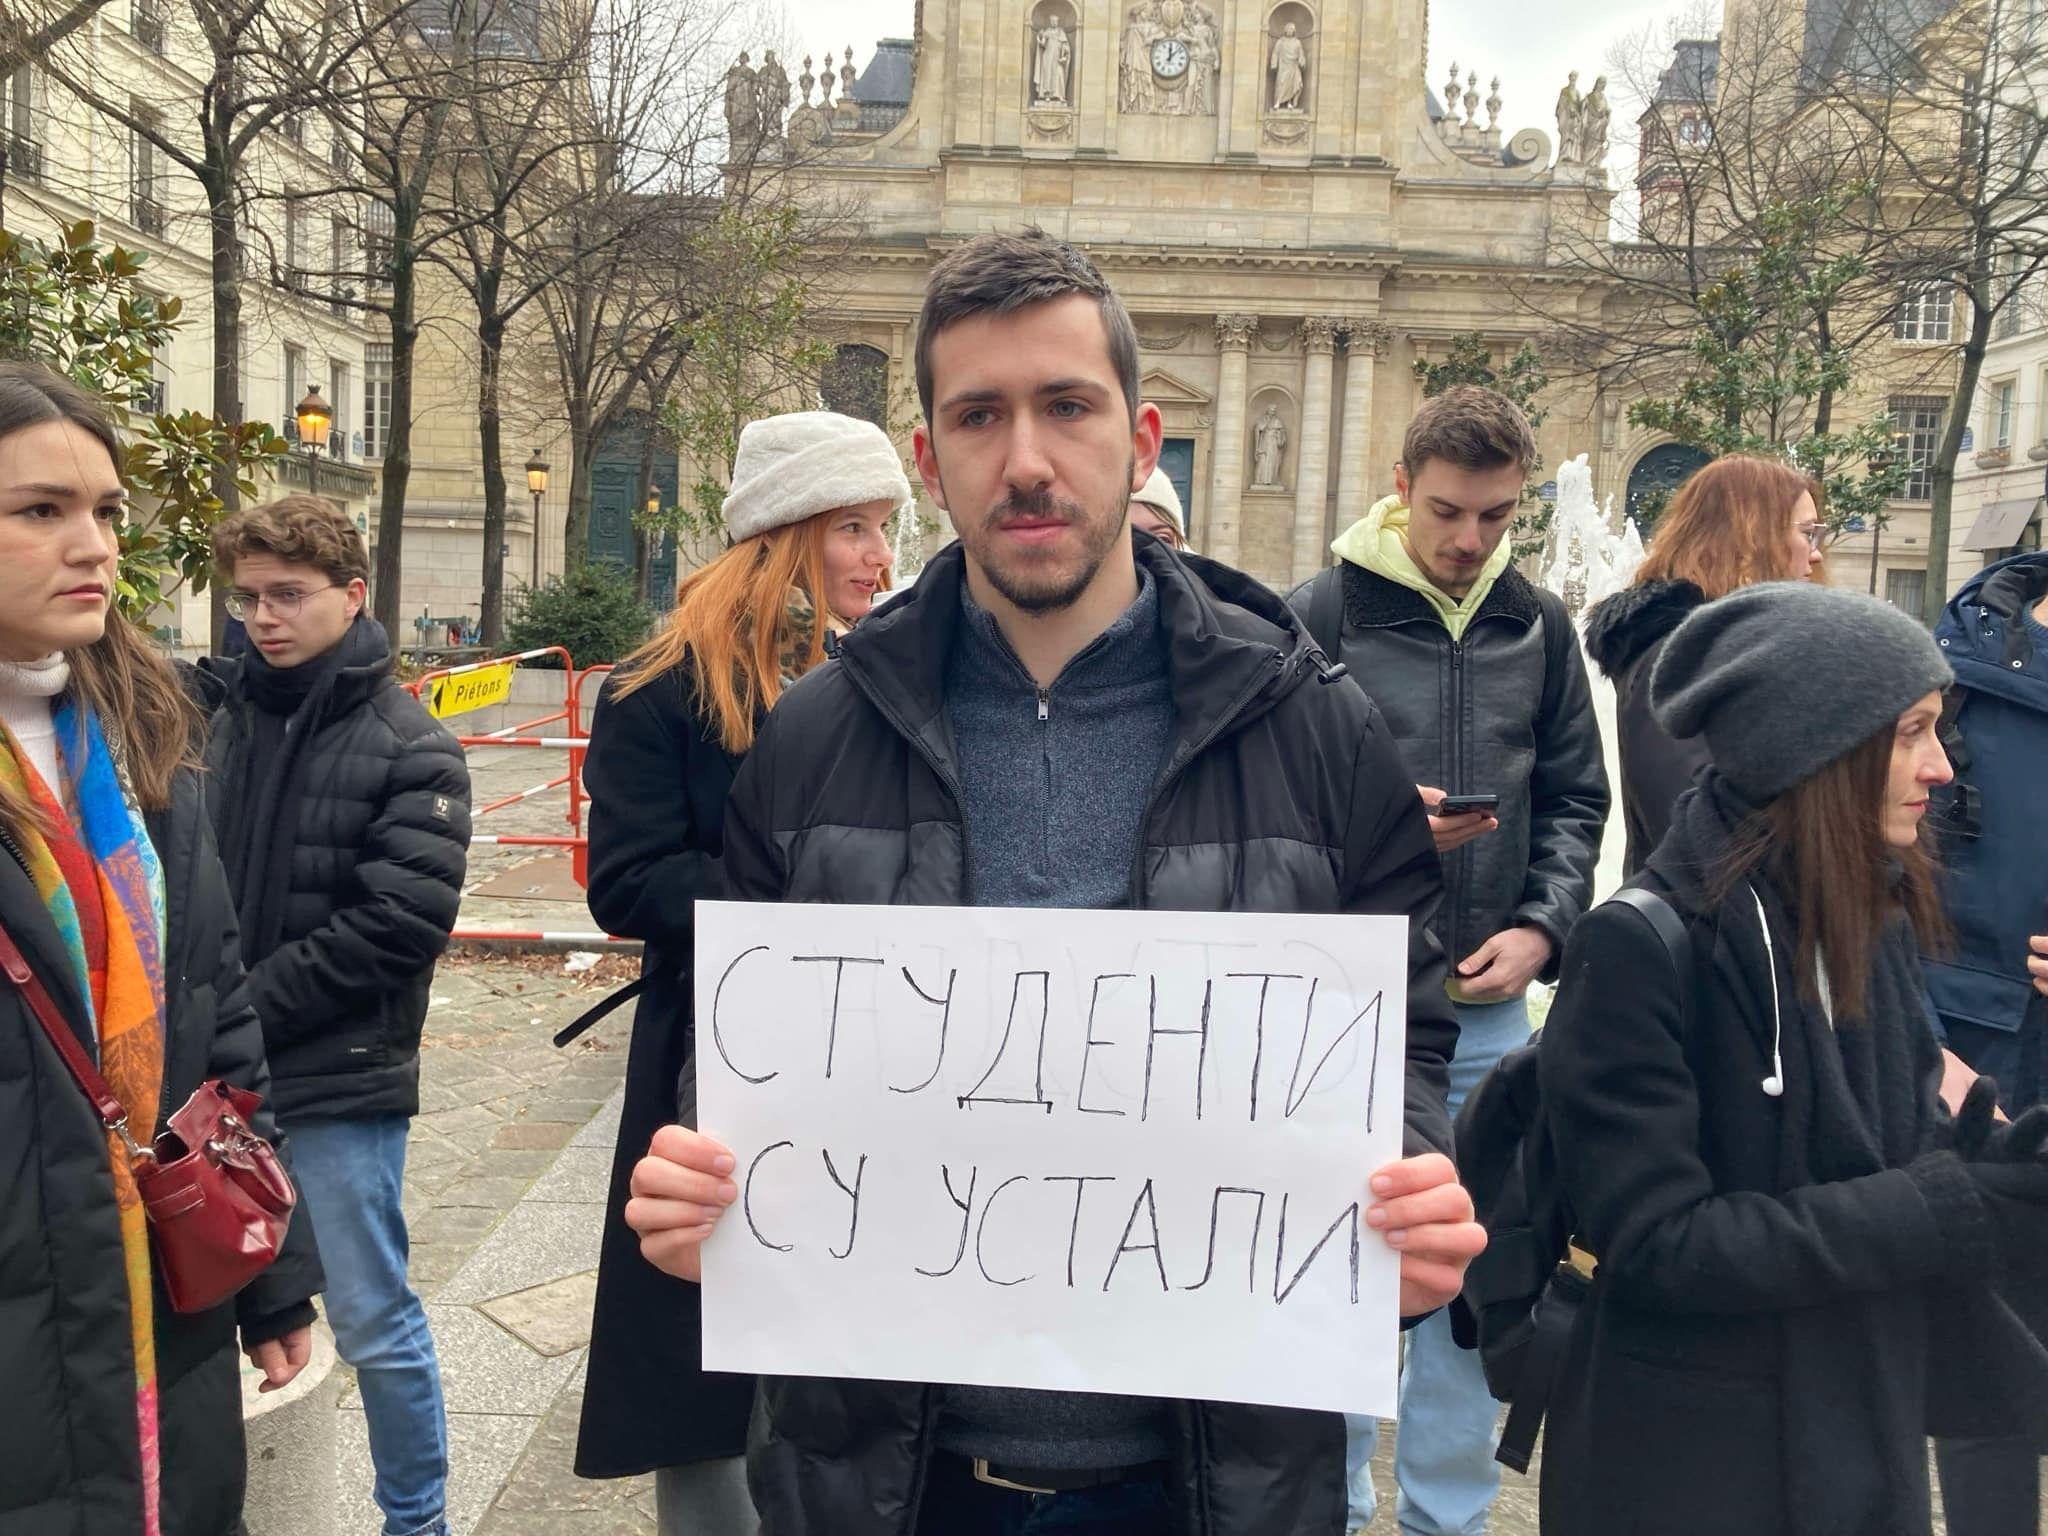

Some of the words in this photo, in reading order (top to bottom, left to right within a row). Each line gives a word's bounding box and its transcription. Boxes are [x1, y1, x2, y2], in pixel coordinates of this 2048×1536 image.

[455, 679, 502, 705] Piétons
[712, 945, 1383, 1134] СТУДЕНТИ
[744, 1140, 868, 1260] СУ
[914, 1164, 1360, 1305] УСТАЛИ
